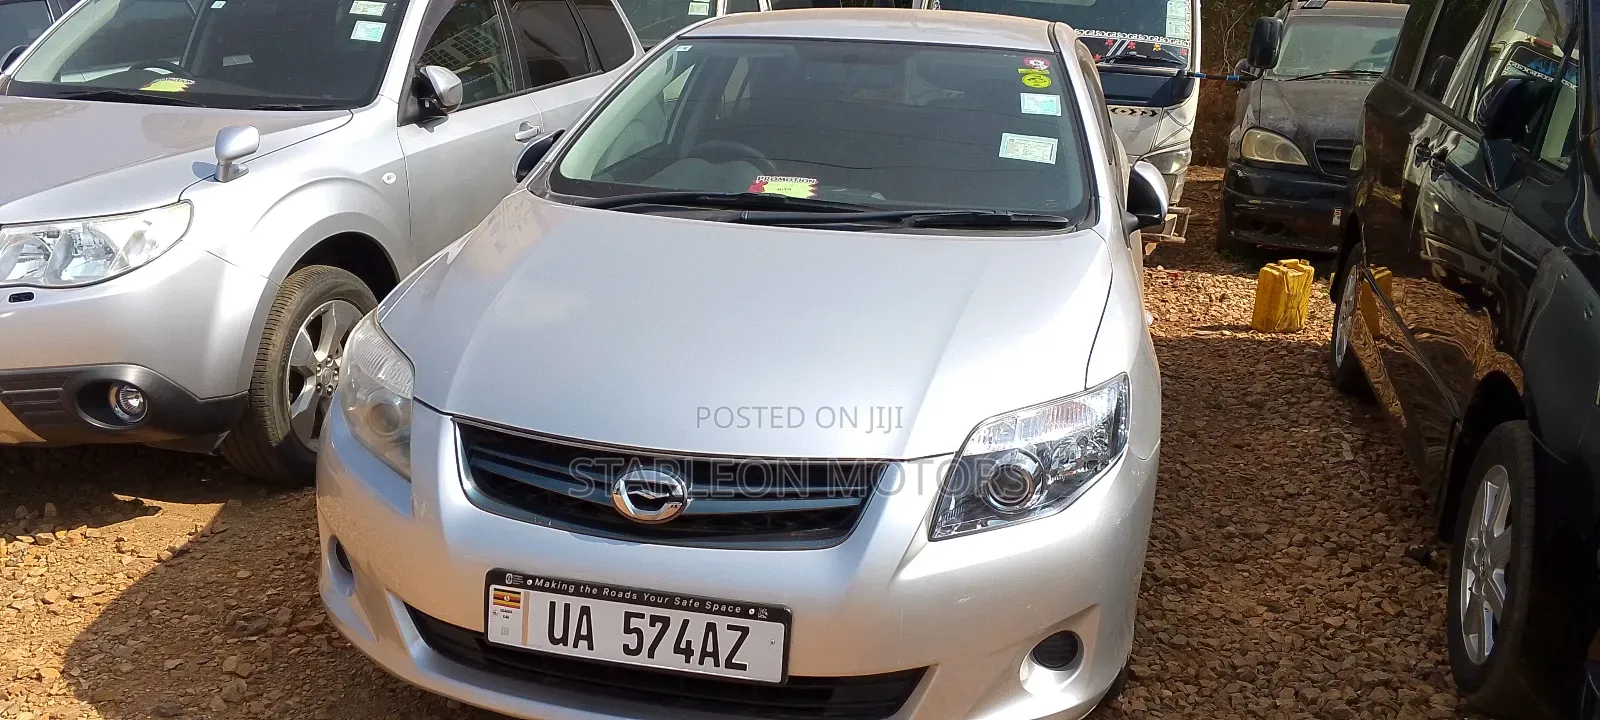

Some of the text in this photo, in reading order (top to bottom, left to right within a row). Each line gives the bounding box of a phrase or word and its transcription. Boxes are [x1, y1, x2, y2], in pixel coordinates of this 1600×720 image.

[534, 578, 575, 593] Making
[580, 585, 598, 595] the
[602, 587, 638, 600] Roads
[643, 593, 669, 604] Your
[673, 597, 700, 608] Safe
[705, 601, 742, 612] Space
[547, 600, 750, 671] UA 574AZ
